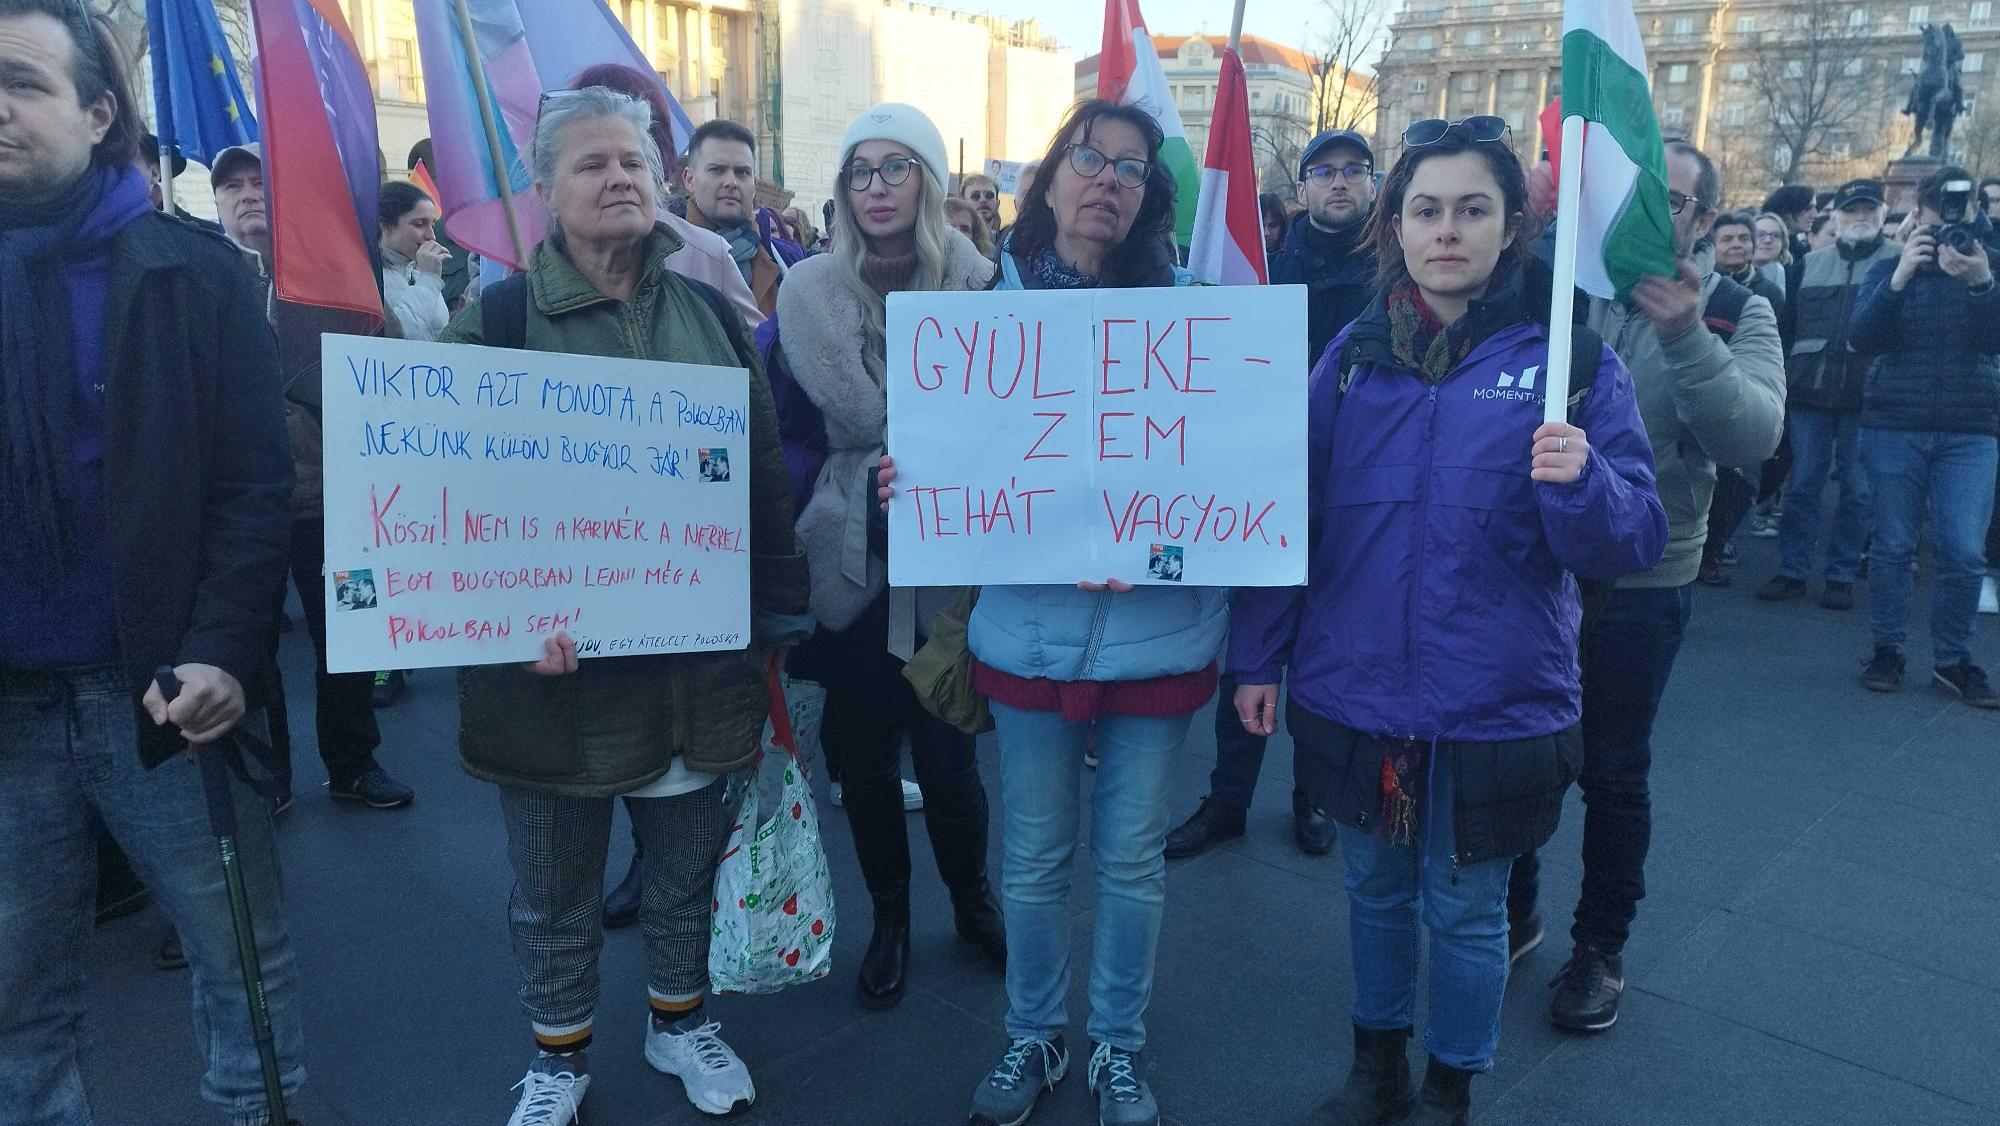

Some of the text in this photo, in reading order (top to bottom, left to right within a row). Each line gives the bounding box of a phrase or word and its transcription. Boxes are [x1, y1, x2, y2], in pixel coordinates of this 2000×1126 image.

[347, 355, 461, 406] VIKTOR
[477, 372, 528, 407] AZT
[650, 392, 663, 424] A
[365, 421, 472, 461] NEKÜNK
[485, 431, 549, 462] KÜLÖN
[560, 436, 638, 474] BUGYOR
[465, 509, 509, 544] NEM
[522, 515, 539, 541] IS
[659, 521, 670, 545] A
[906, 476, 1288, 548] TEHÁT VAGYOK.
[386, 559, 701, 598] EGY BUGYORBAN LENNI MÉG A
[609, 638, 634, 651] EGY
